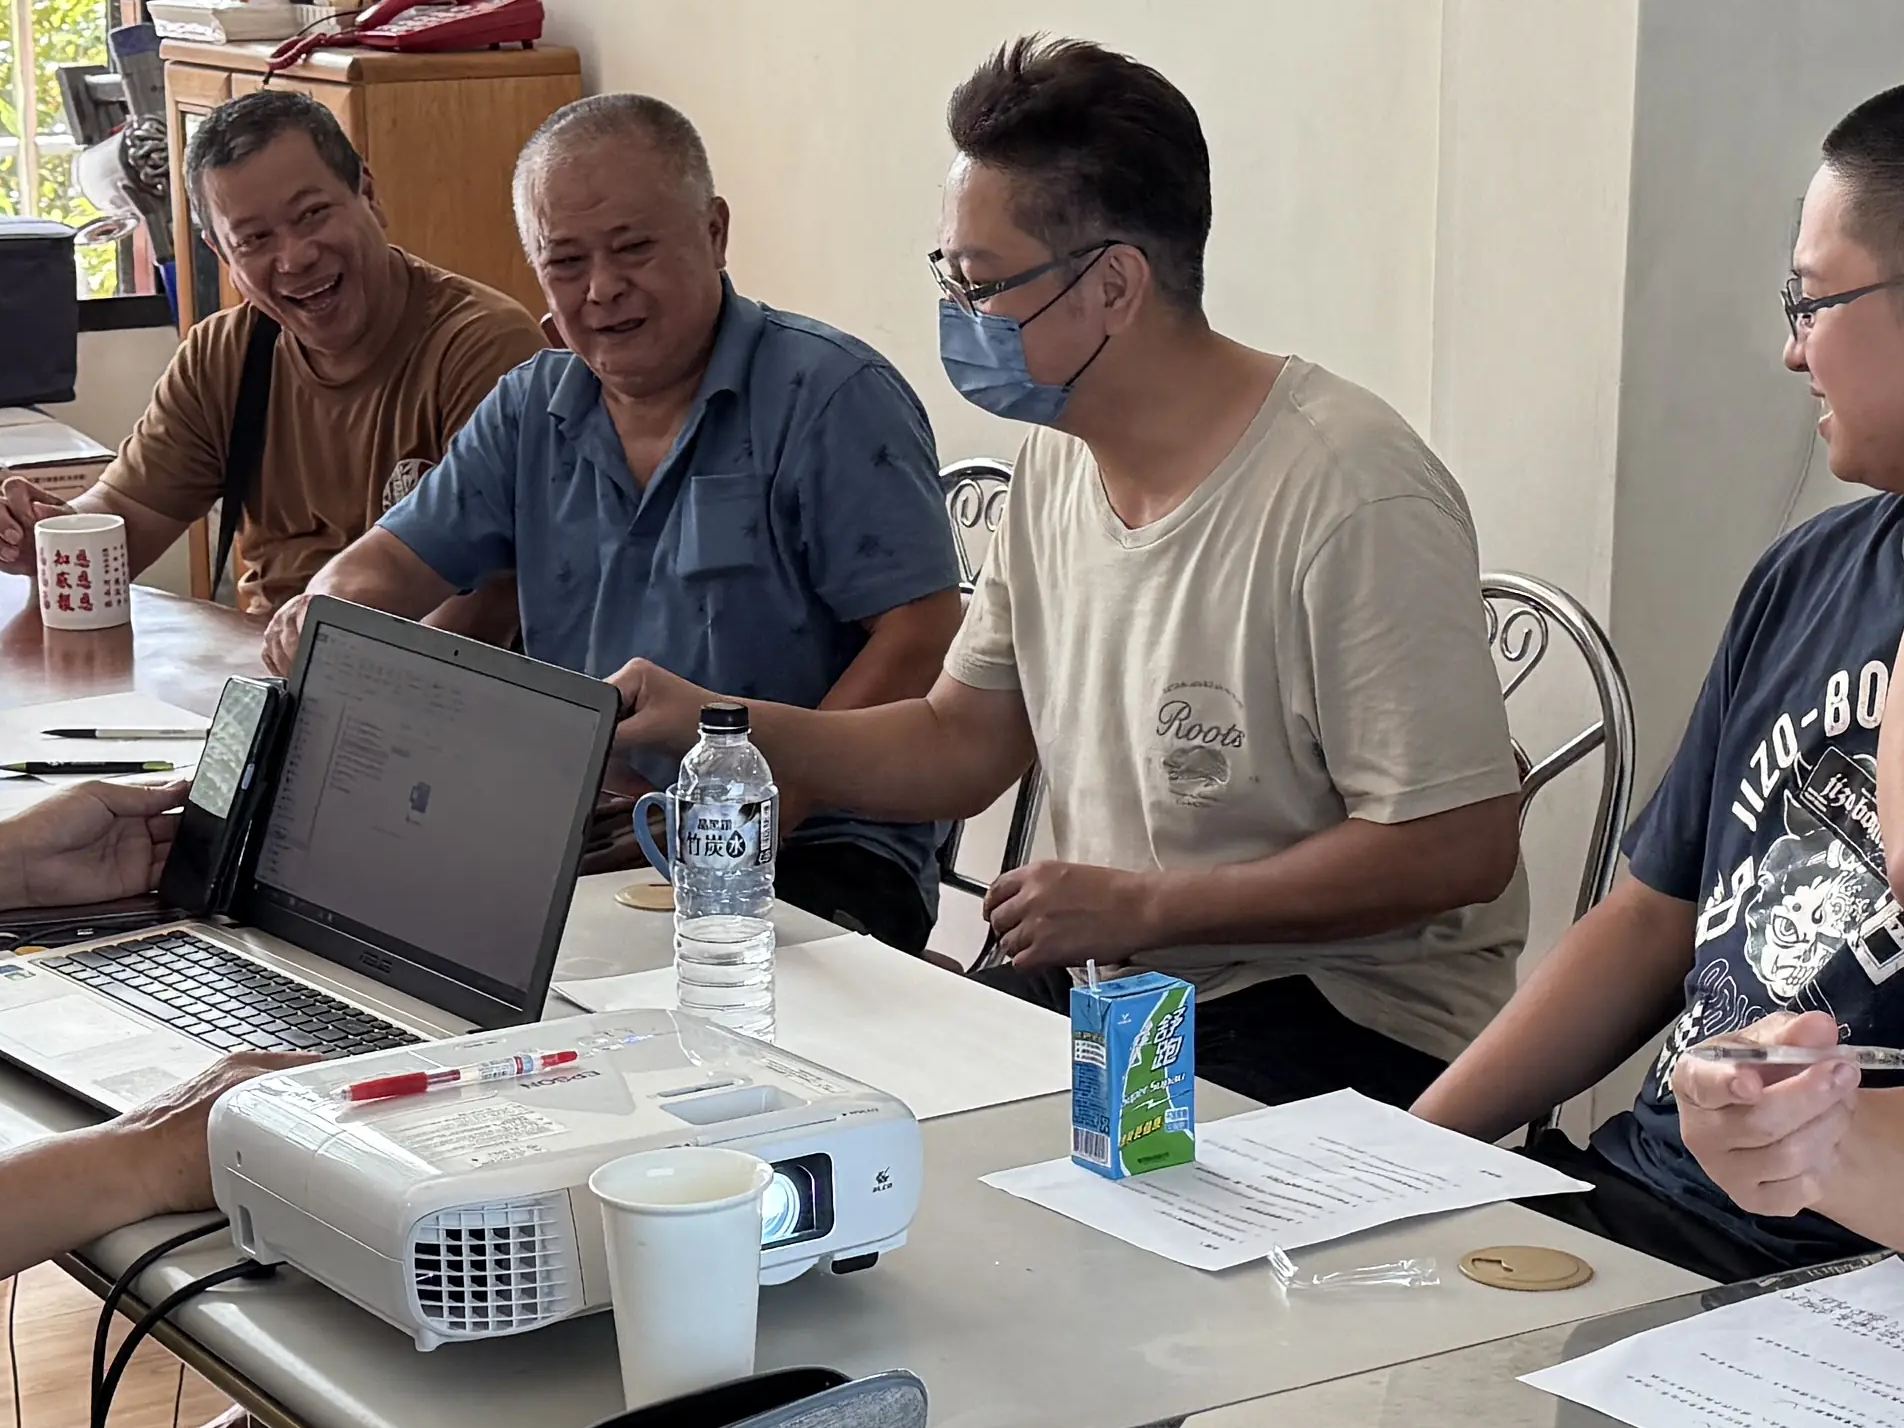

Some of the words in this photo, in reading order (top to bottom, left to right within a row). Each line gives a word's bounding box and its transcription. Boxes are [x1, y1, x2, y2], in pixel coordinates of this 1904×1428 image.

[1156, 699, 1246, 748] Roots
[686, 830, 746, 858] 竹炭水
[1151, 1006, 1188, 1072] 舒跑
